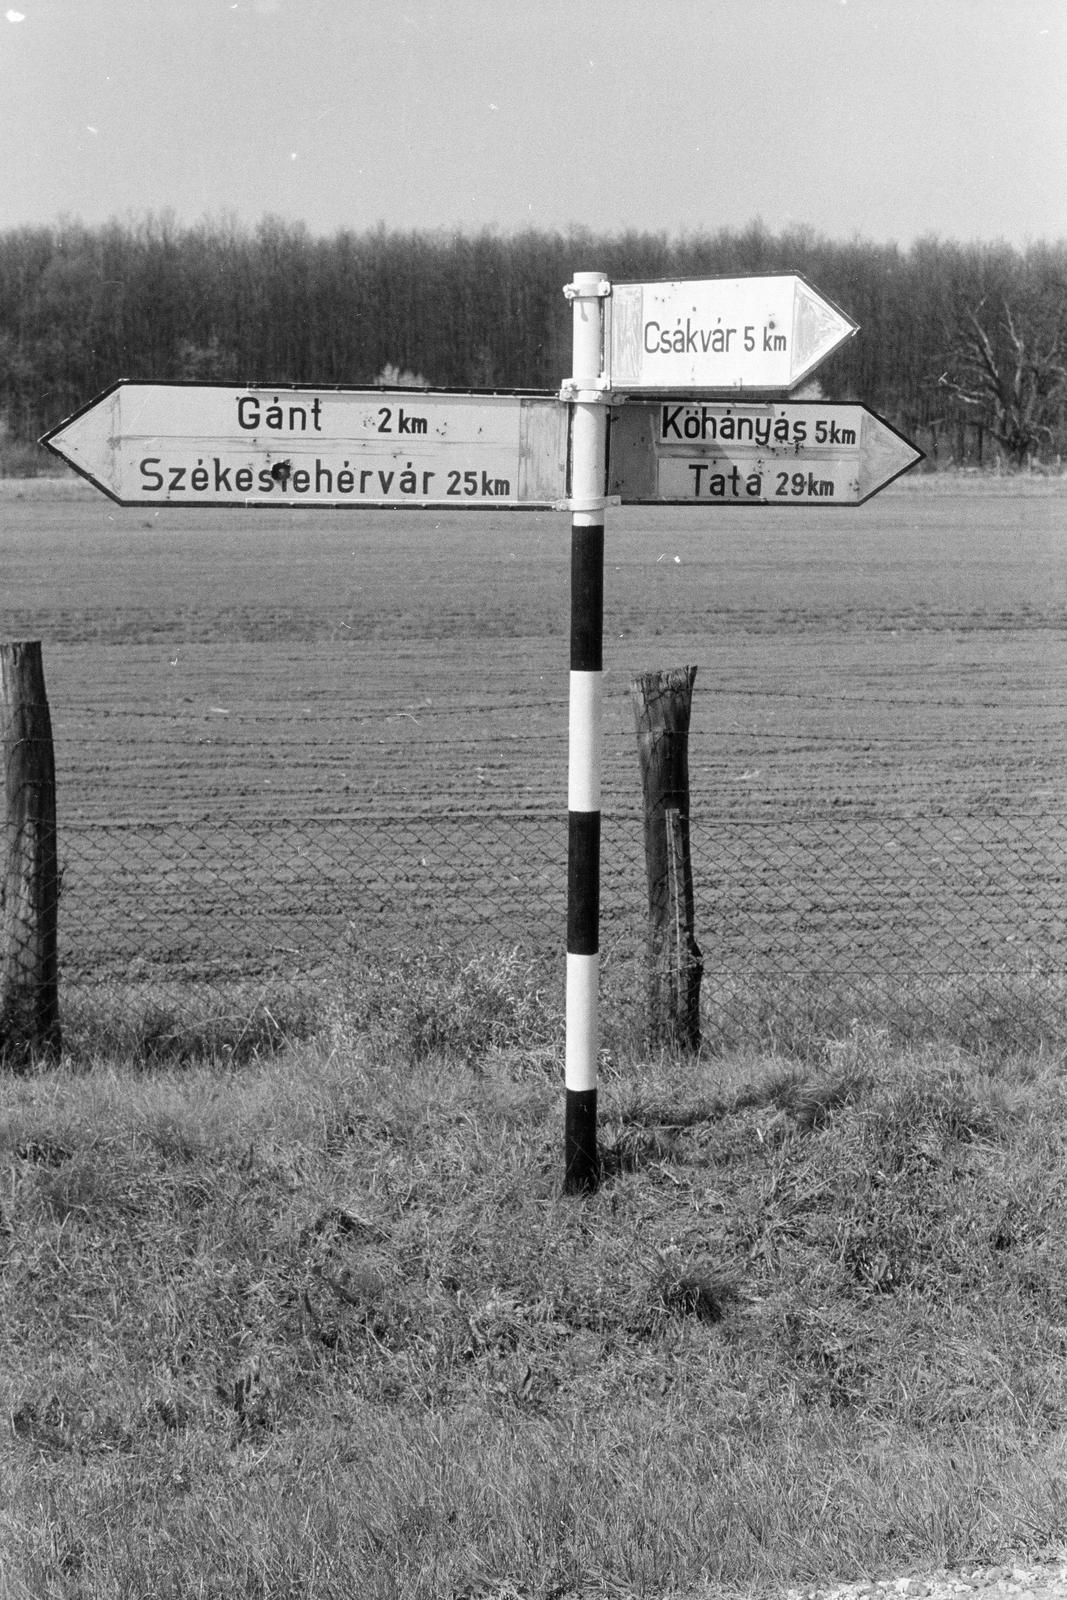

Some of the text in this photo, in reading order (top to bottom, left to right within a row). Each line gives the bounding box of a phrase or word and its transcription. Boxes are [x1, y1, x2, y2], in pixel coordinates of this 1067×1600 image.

[644, 317, 787, 353] Csákvár 5 km
[238, 396, 322, 431] Gánt
[662, 406, 807, 446] Köhányás
[689, 464, 762, 496] Tata
